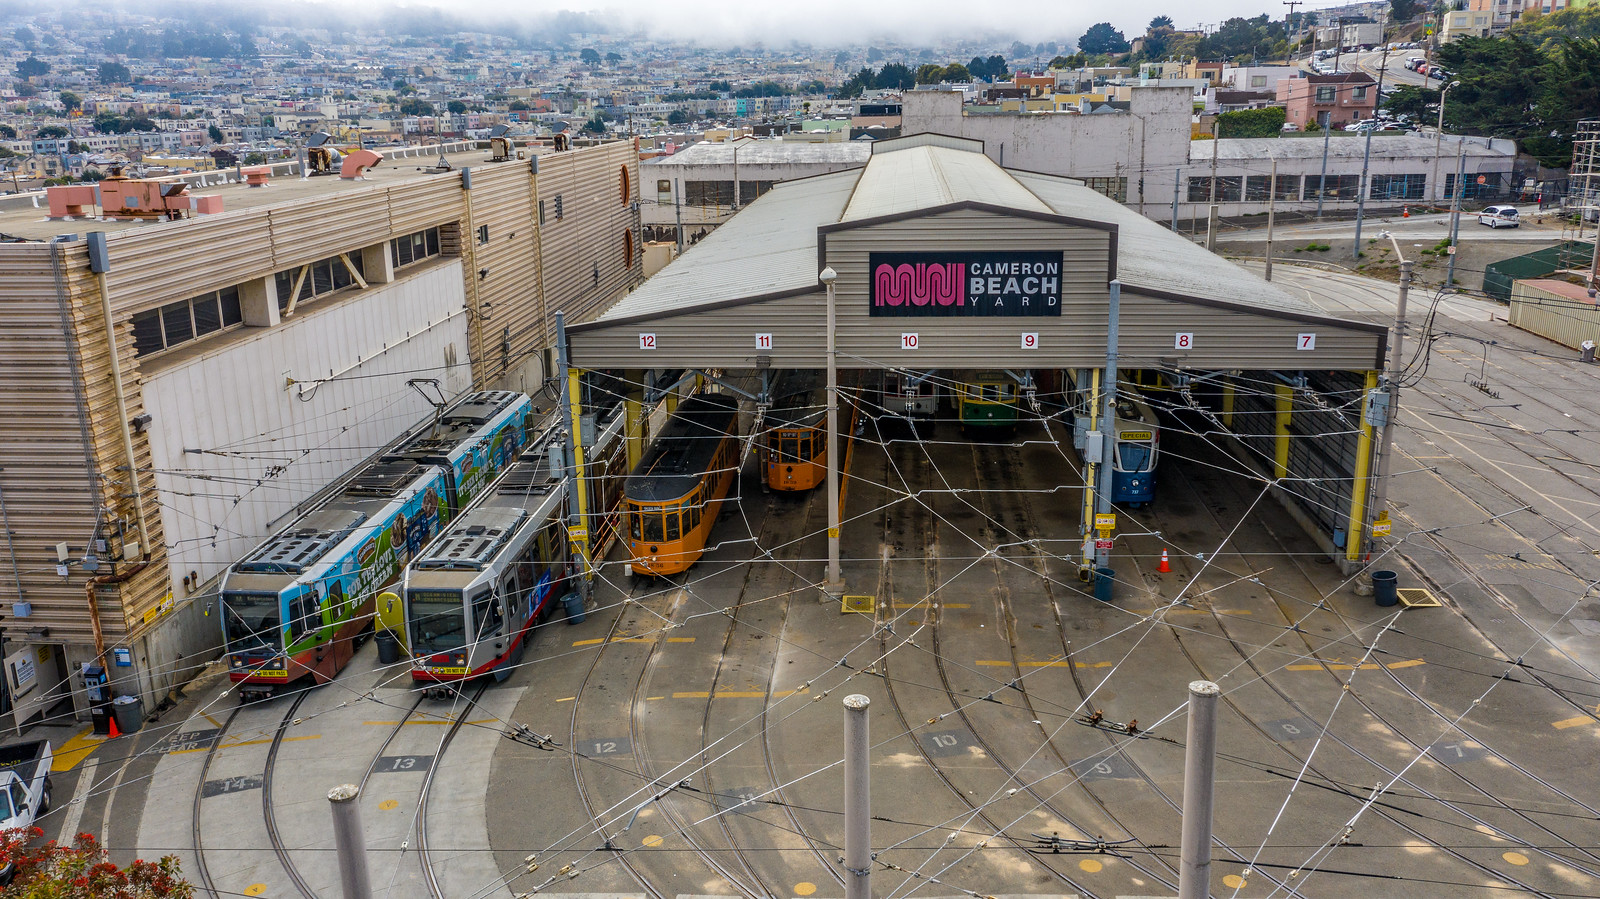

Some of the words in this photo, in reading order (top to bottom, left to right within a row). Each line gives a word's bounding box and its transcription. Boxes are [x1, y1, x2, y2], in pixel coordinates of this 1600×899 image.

[970, 262, 1058, 275] CAMERON
[970, 277, 1057, 295] BEACH
[970, 297, 1057, 306] YARD
[641, 335, 655, 347] 12
[758, 335, 769, 347] 11
[903, 335, 917, 347] 10
[1025, 335, 1035, 347] 9
[1179, 335, 1189, 347] 8
[1302, 336, 1311, 347] 7
[347, 578, 362, 599] FOR
[361, 562, 376, 585] THE
[375, 547, 393, 573] LOVE
[370, 563, 393, 592] CREAM
[1281, 723, 1301, 735] 8
[932, 733, 958, 748] 10
[594, 741, 617, 754] 12
[392, 758, 416, 770] 13
[220, 777, 246, 792] 14
